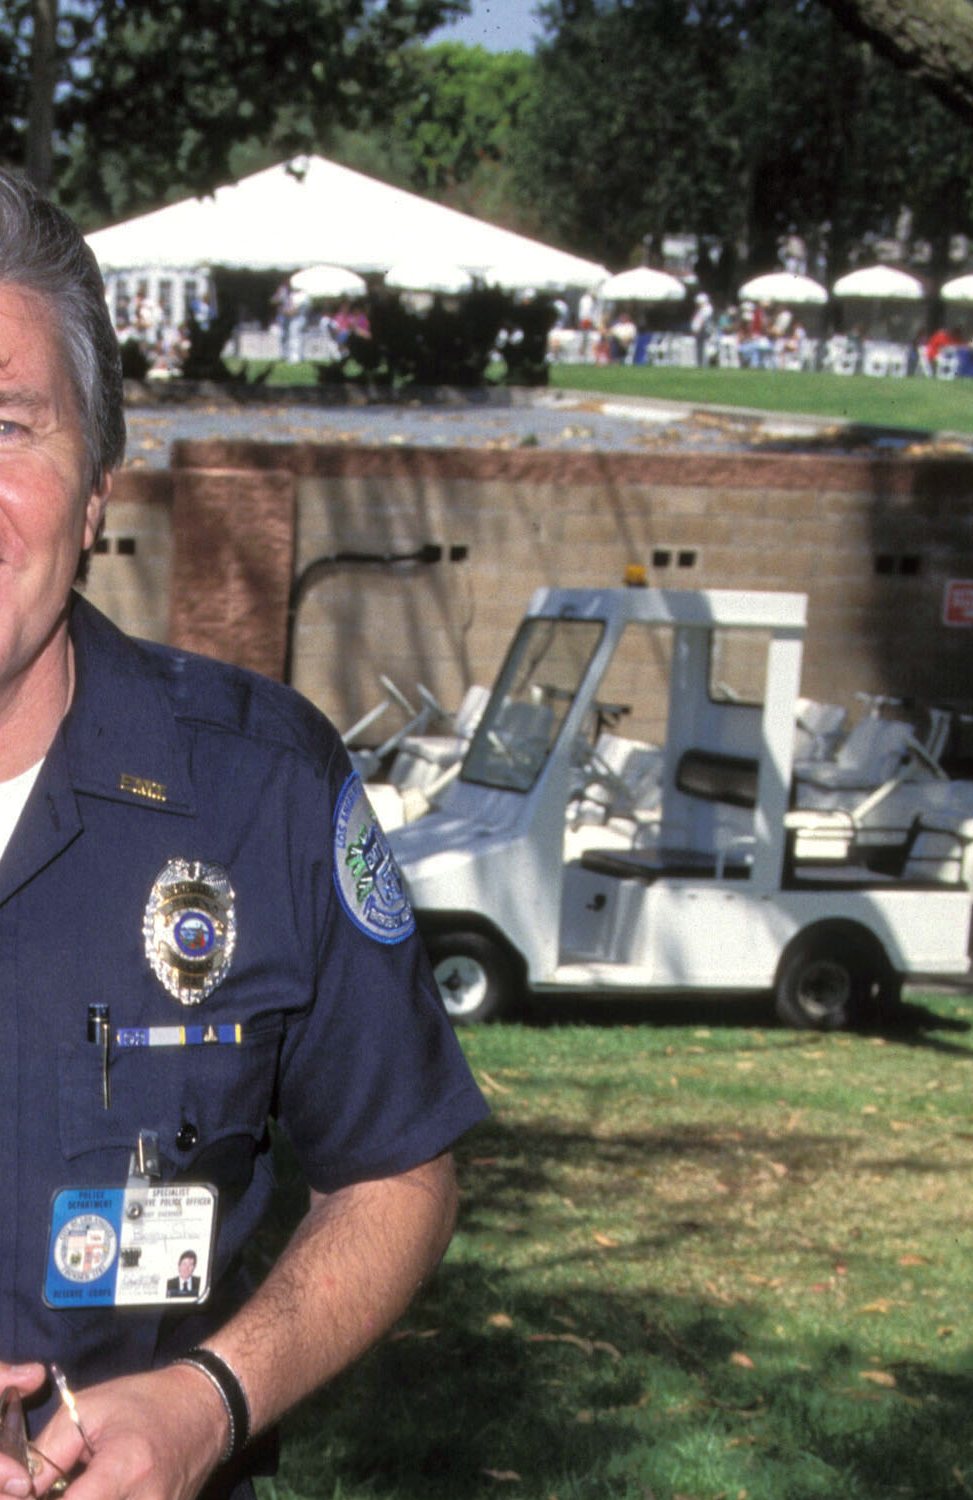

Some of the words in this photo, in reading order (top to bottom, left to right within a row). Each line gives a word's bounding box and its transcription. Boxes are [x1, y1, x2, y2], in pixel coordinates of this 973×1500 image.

[152, 1187, 190, 1197] SPECIALIST
[68, 1200, 113, 1209] DEPARTMENT
[186, 1198, 211, 1206] OFFICER
